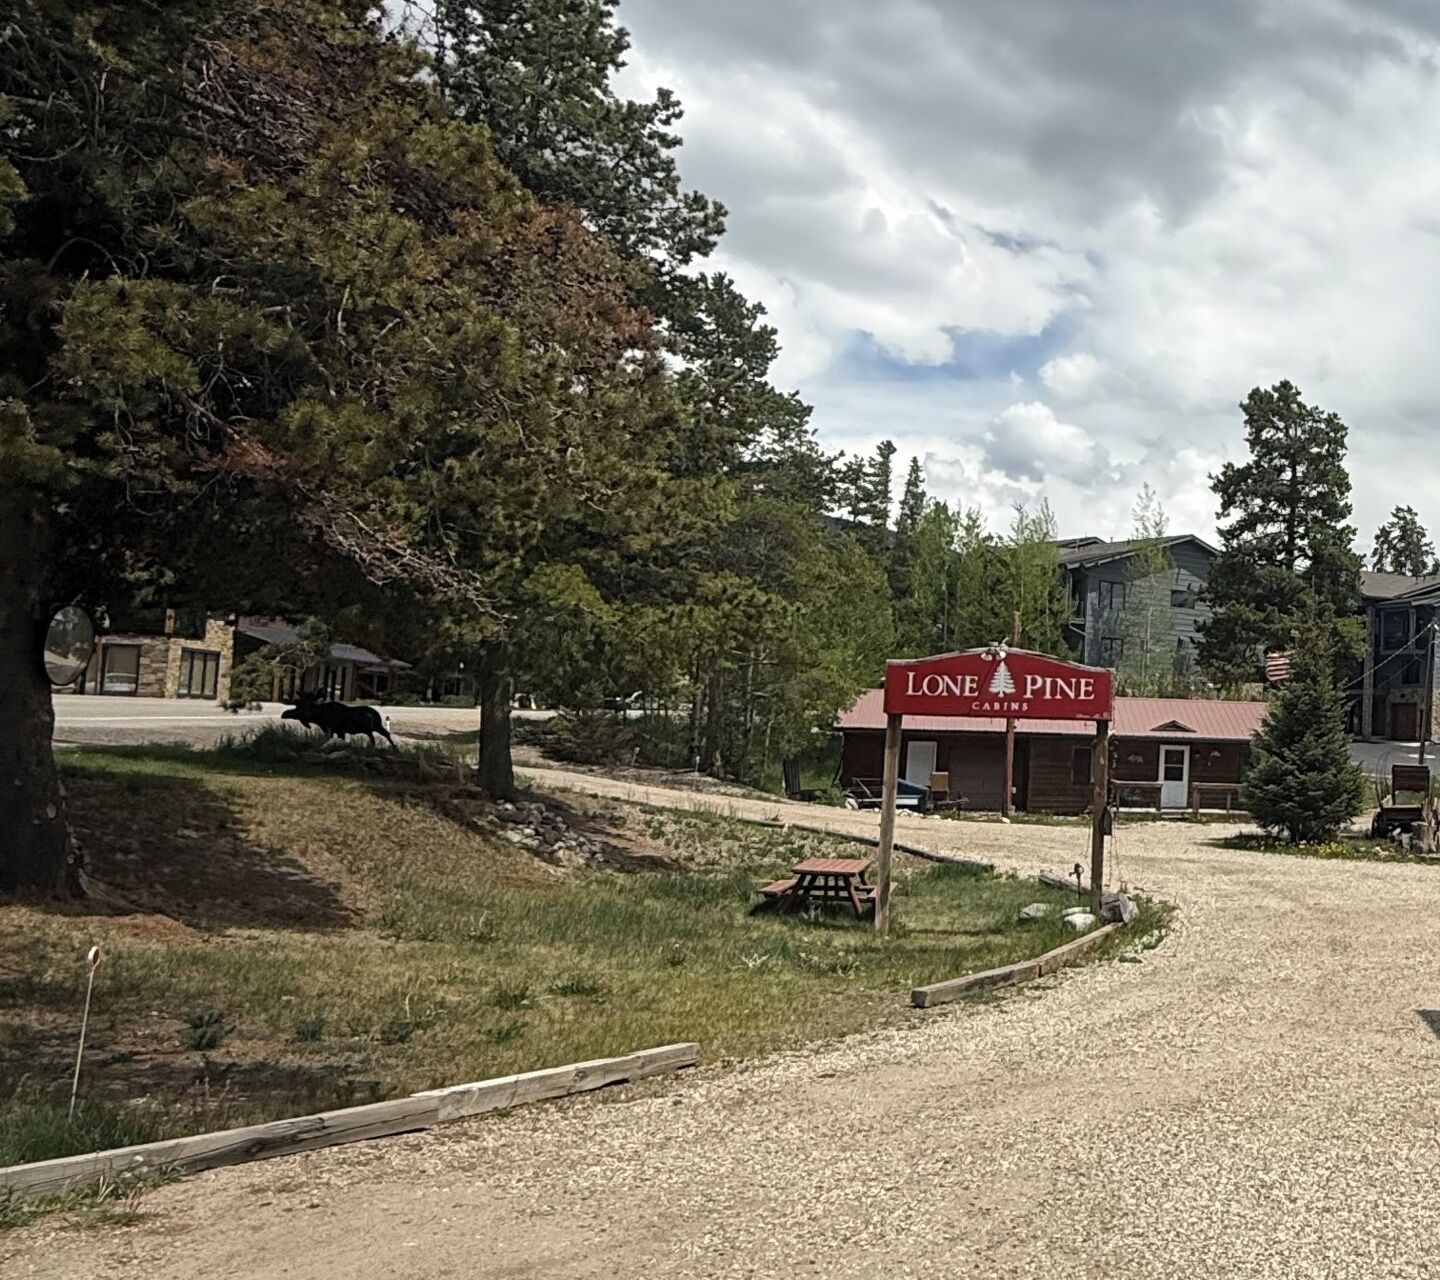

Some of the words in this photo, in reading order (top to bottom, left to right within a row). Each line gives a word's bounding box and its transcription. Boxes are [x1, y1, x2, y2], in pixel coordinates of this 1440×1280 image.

[905, 672, 979, 697] LONE
[1023, 674, 1095, 700] PINE
[971, 701, 1029, 711] CABINS
